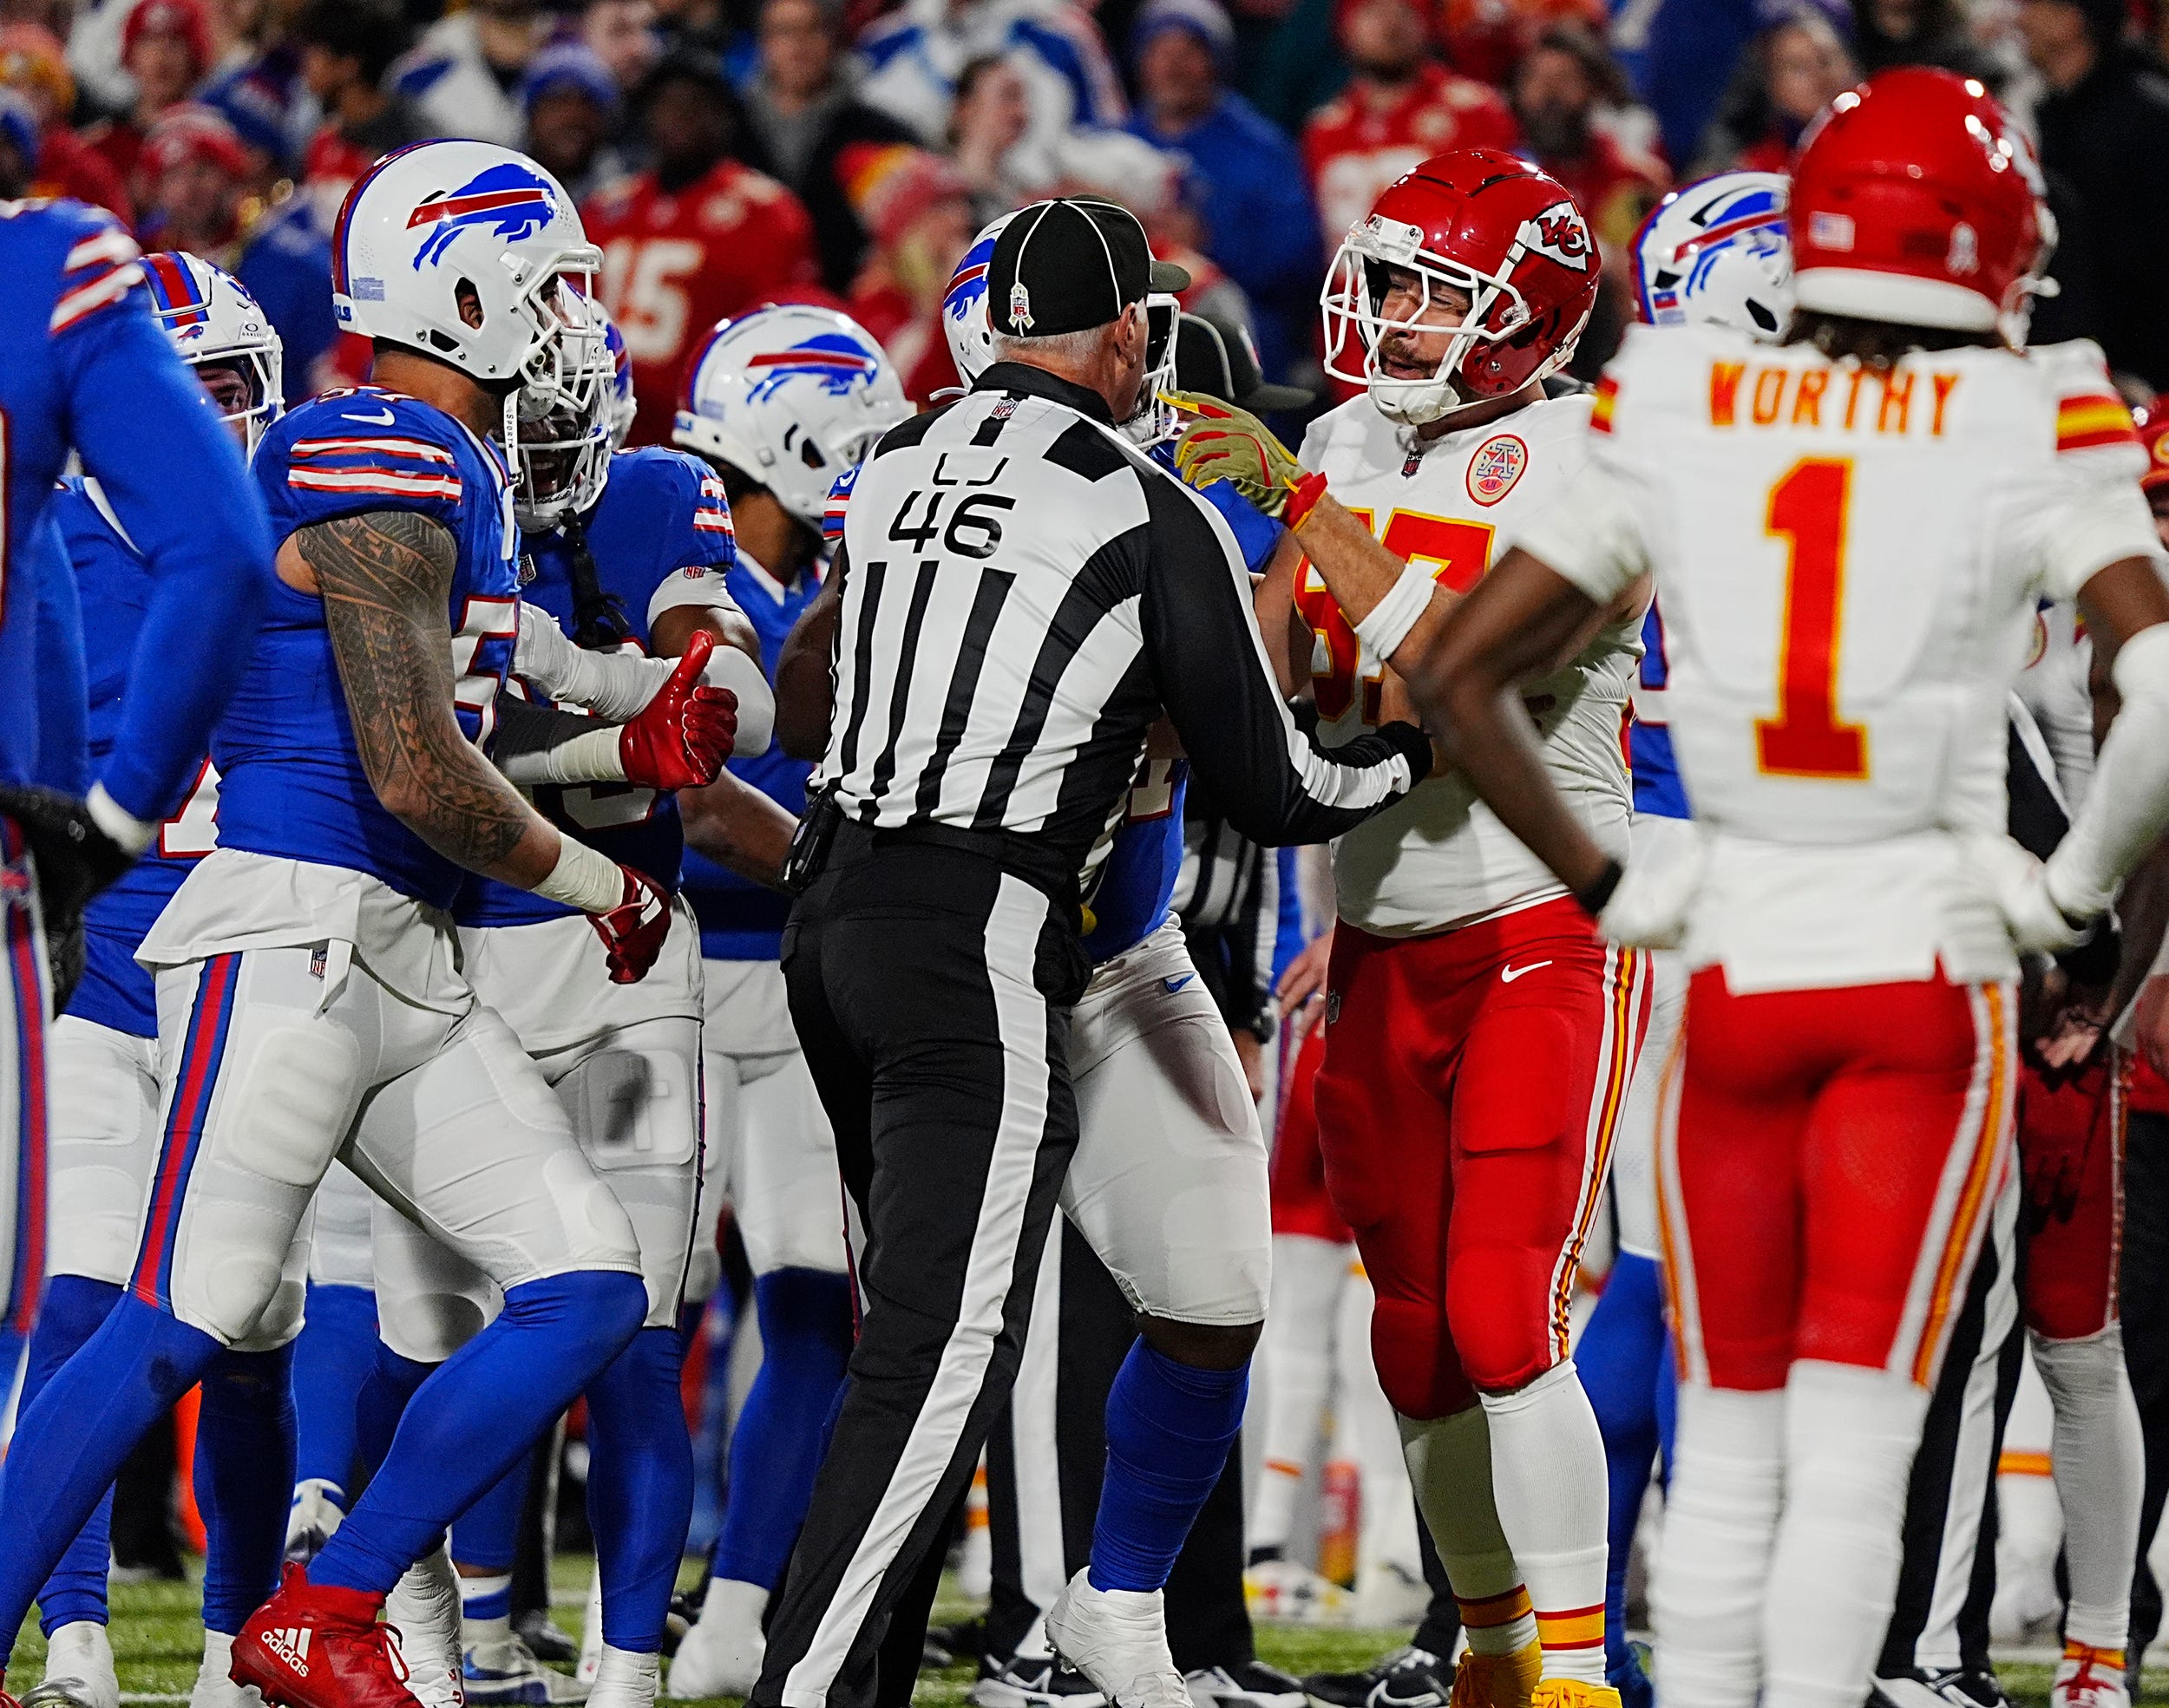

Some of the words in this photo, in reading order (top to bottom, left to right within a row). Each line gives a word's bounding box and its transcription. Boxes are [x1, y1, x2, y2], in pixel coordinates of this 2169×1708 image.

[1537, 215, 1587, 258] KC
[599, 236, 706, 366] 15
[1709, 361, 1959, 437] WORTHY
[932, 452, 1010, 487] LJ
[1477, 443, 1515, 479] A
[888, 490, 1017, 560] 46
[1753, 455, 1871, 780] 1
[261, 1630, 310, 1678] adidas
